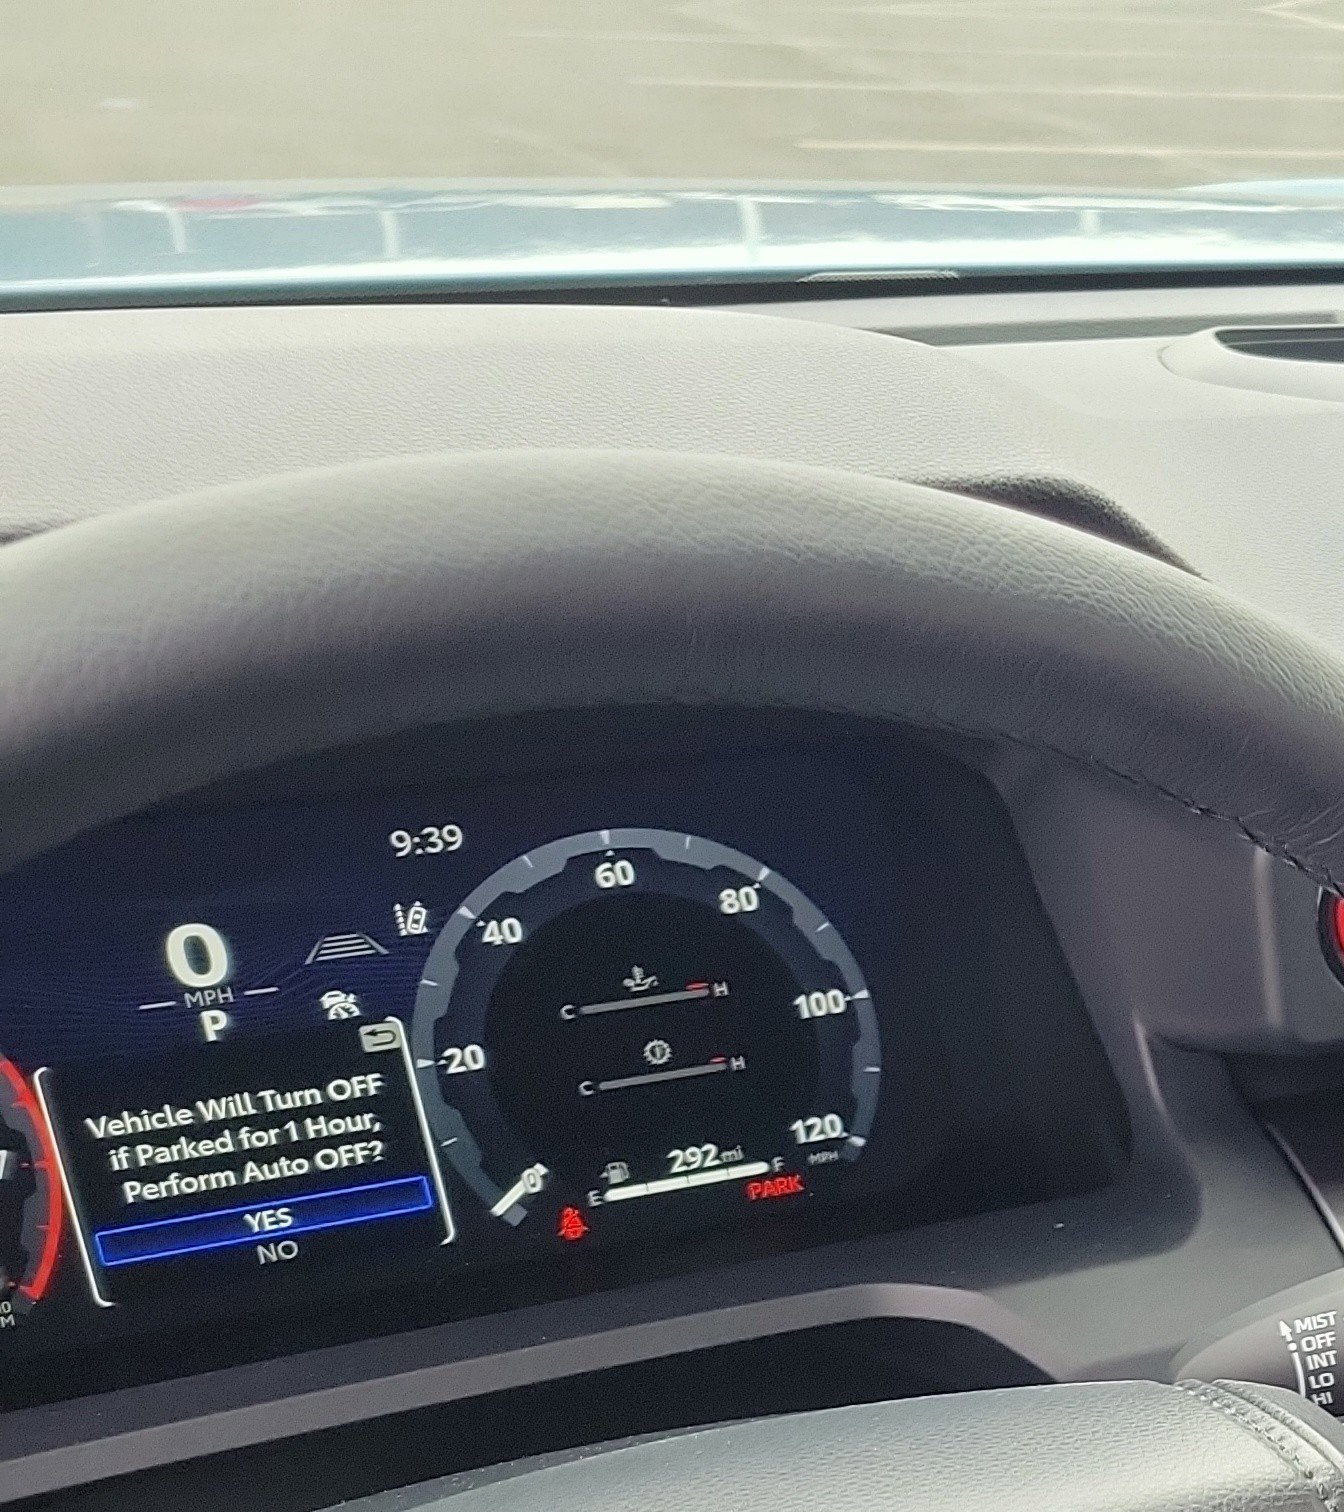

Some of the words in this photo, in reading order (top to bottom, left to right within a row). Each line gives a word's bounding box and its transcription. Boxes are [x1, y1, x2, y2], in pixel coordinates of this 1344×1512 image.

[390, 824, 463, 856] 9:39
[595, 860, 636, 888] 60
[719, 885, 760, 915] 80
[480, 916, 522, 945] 40
[166, 924, 229, 987] 0
[184, 987, 234, 1009] MPH
[559, 1004, 577, 1020] C
[714, 981, 730, 997] H
[793, 988, 847, 1020] 100
[200, 1009, 230, 1042] P
[443, 1045, 485, 1075] 20
[578, 1080, 594, 1097] C
[729, 1055, 747, 1071] H
[84, 1104, 194, 1139] Vehicle
[195, 1091, 257, 1123] Will
[257, 1086, 323, 1114] Turn
[325, 1072, 385, 1102] OFF
[108, 1147, 130, 1172] if
[135, 1129, 234, 1168] Parked
[237, 1125, 280, 1151] for
[283, 1119, 300, 1143] 1
[303, 1112, 383, 1141] Hour,
[790, 1113, 845, 1145] 120
[122, 1170, 237, 1205] Perform
[242, 1155, 310, 1186] Auto
[312, 1139, 386, 1171] OFF?
[666, 1142, 719, 1173] 292
[720, 1144, 743, 1163] mi
[808, 1149, 839, 1165] MPH
[587, 1189, 603, 1207] E
[771, 1156, 786, 1174] F
[747, 1173, 805, 1199] PARK
[242, 1207, 294, 1233] YES
[256, 1240, 300, 1266] NO
[1294, 1310, 1338, 1333] MIST
[1301, 1331, 1338, 1353] OFF
[1306, 1350, 1338, 1369] INT
[1309, 1371, 1336, 1389] LO
[1312, 1391, 1334, 1405] HI
